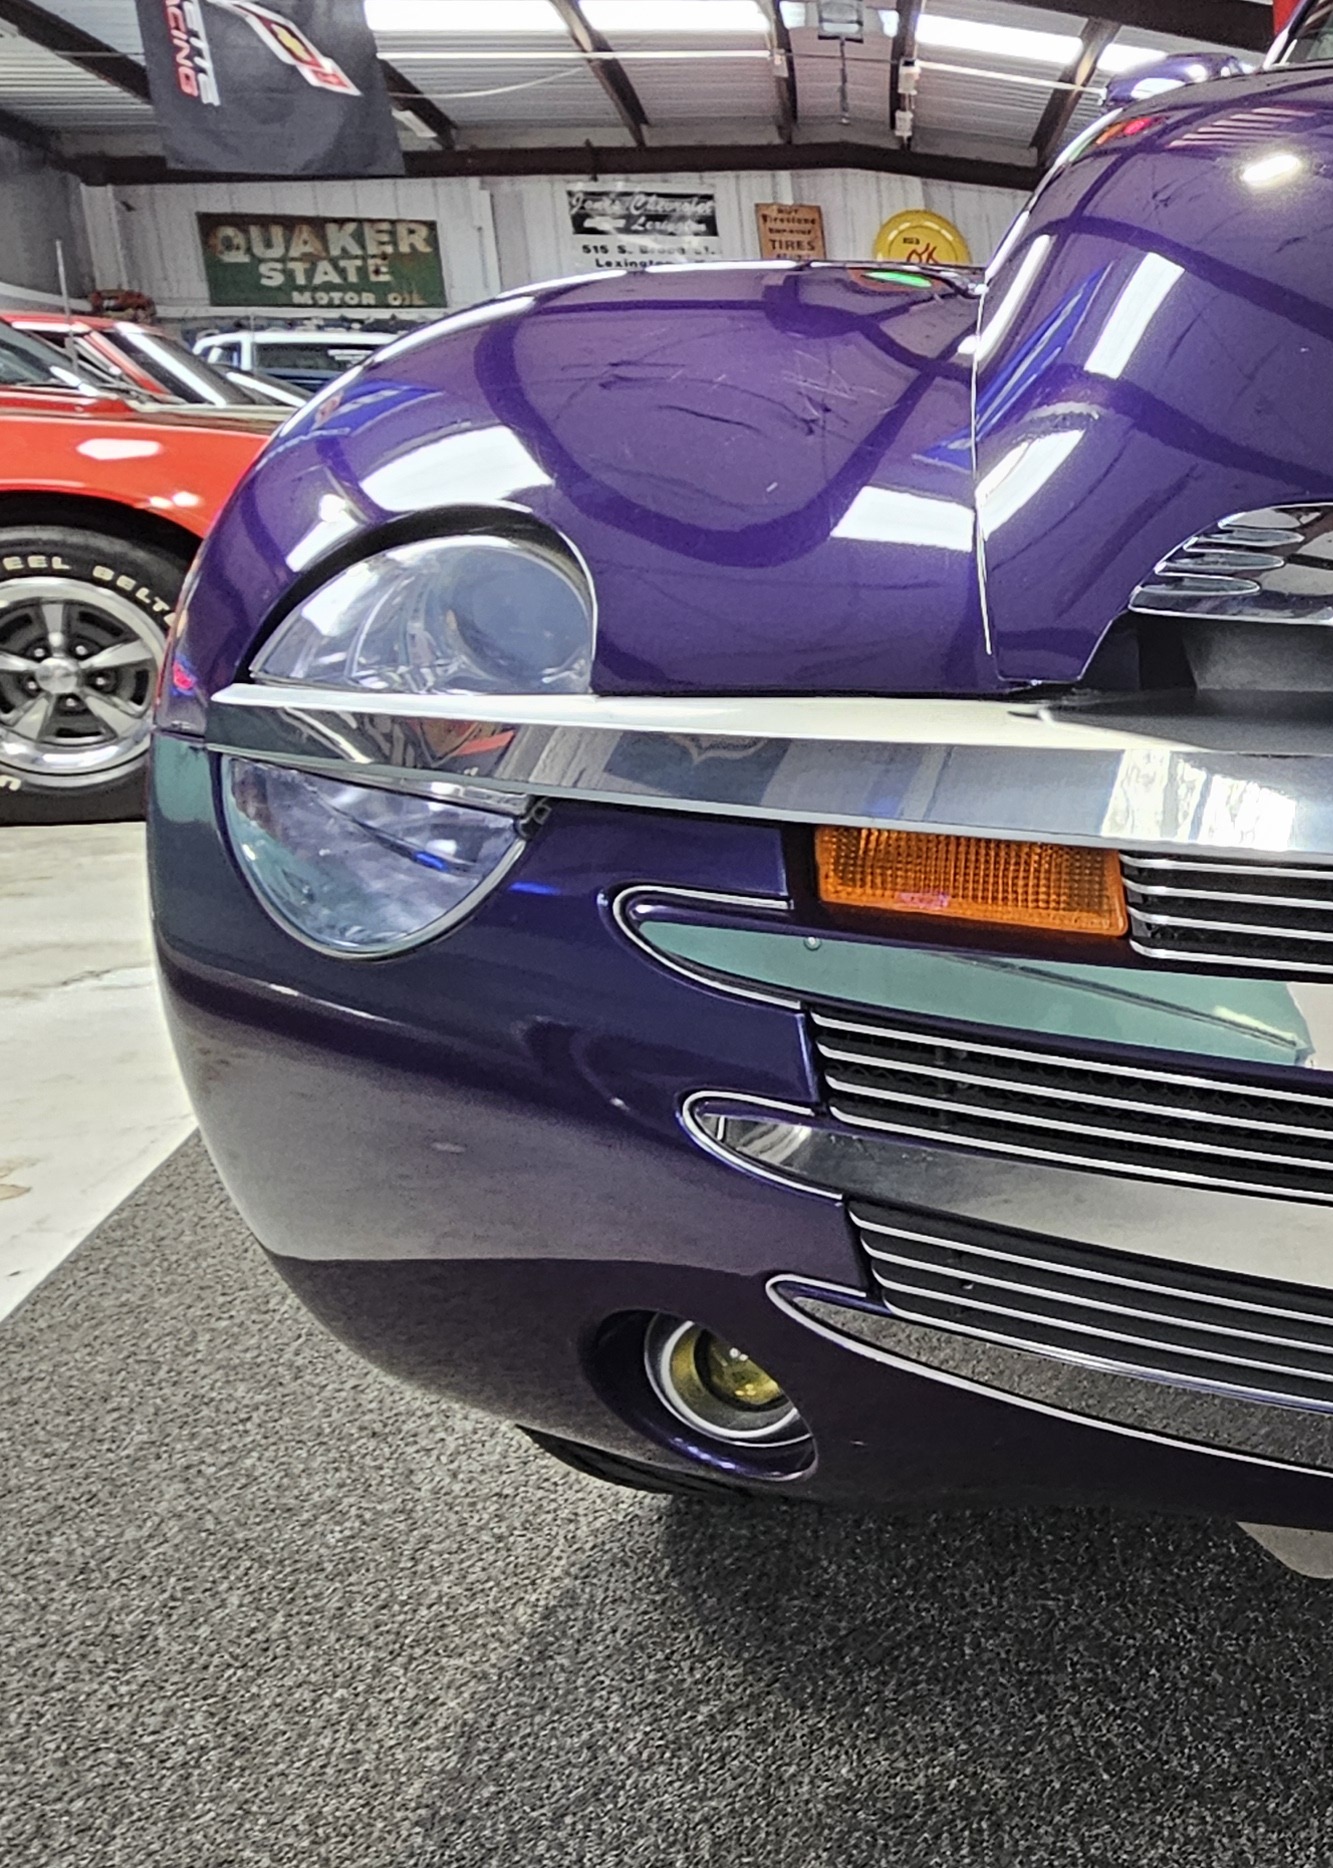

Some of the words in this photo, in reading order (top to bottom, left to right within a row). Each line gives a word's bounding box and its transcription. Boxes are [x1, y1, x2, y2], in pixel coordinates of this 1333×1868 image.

[213, 220, 433, 263] QUAKER
[769, 239, 815, 252] TIRES
[258, 258, 393, 287] STATE
[292, 291, 376, 306] MOTOR
